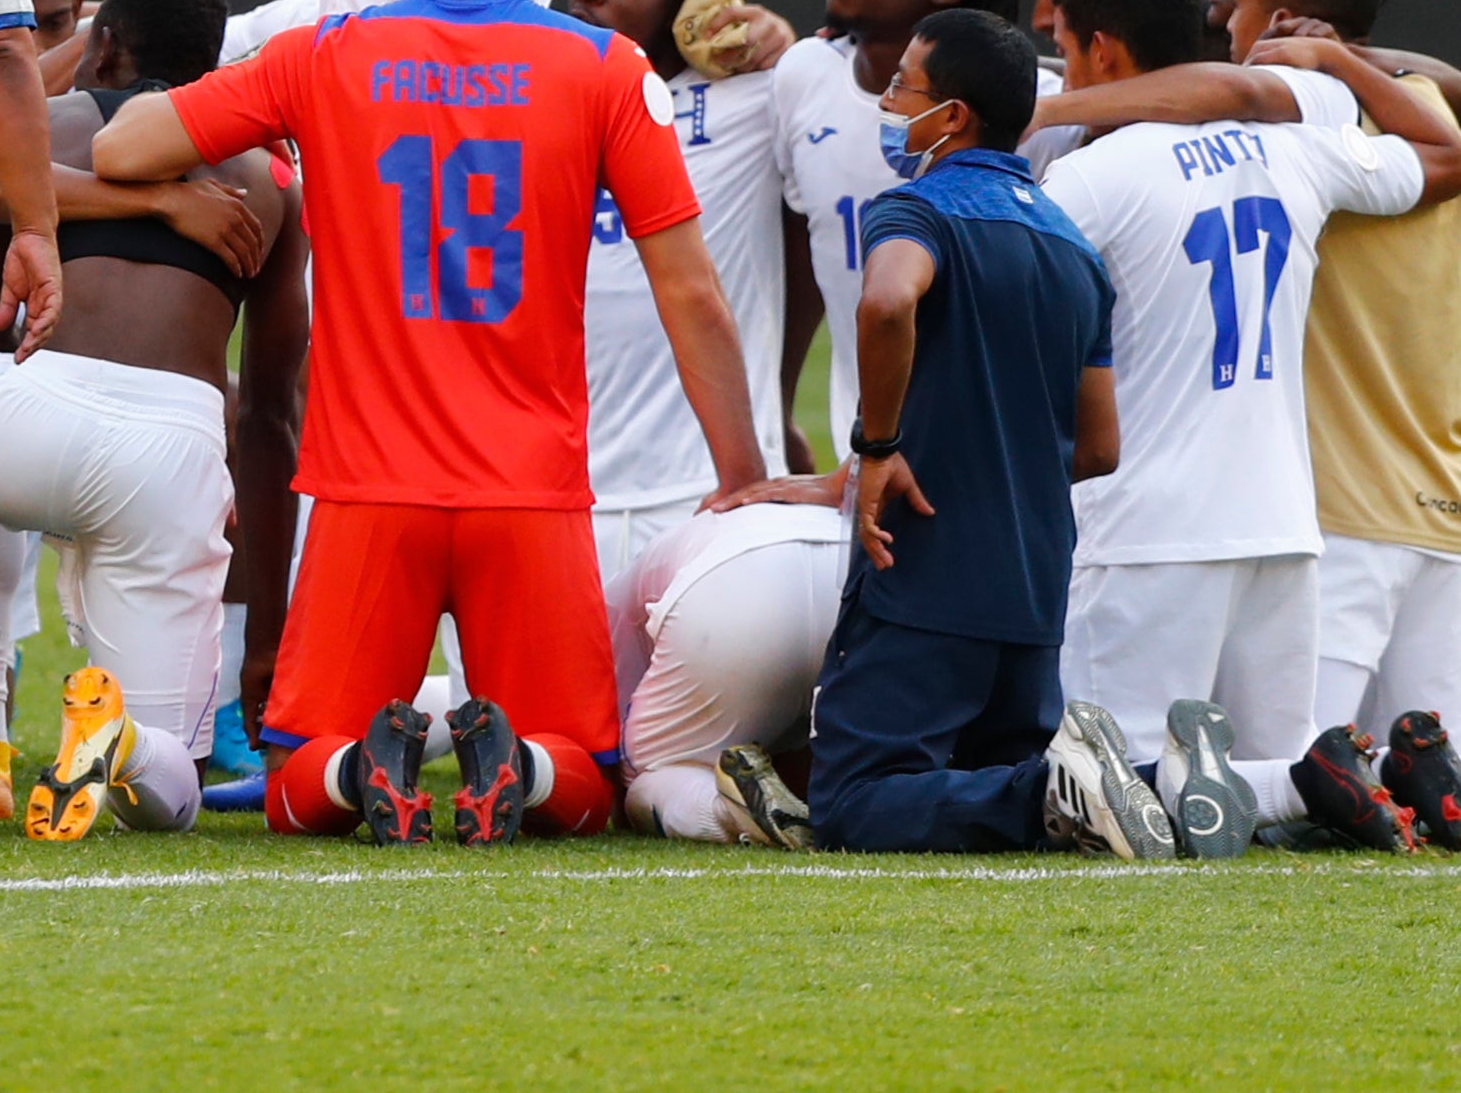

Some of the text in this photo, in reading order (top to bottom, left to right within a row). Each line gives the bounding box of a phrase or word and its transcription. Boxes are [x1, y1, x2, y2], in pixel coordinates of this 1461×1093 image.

[370, 59, 532, 107] FACUSSE
[376, 133, 525, 325] 18
[836, 195, 874, 272] 1
[1182, 195, 1293, 391] 17
